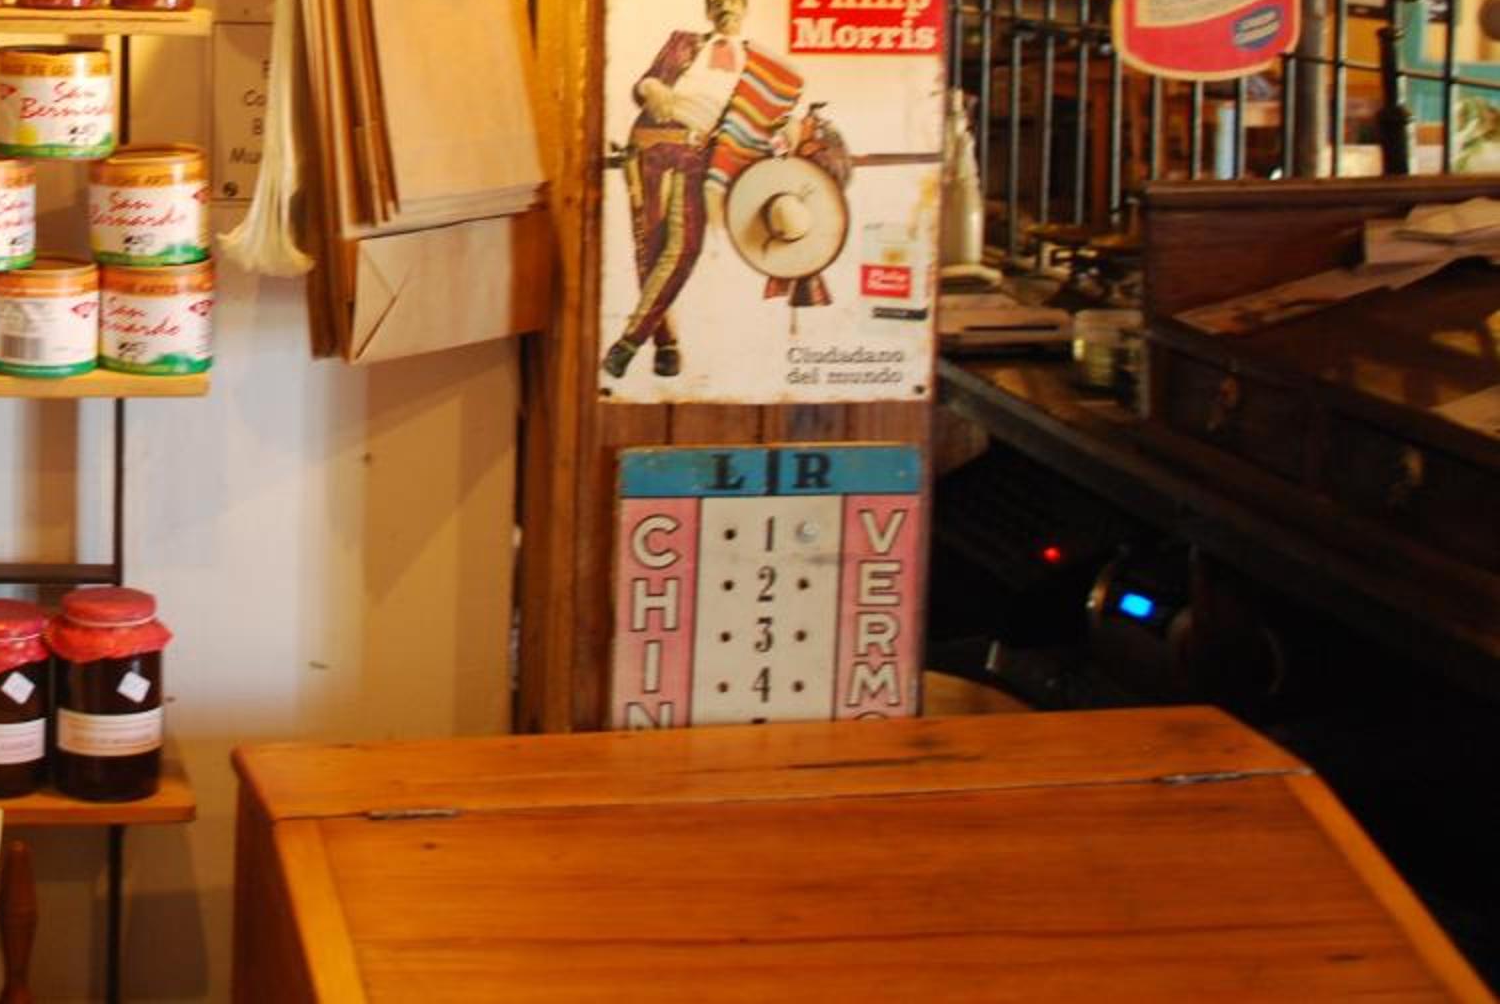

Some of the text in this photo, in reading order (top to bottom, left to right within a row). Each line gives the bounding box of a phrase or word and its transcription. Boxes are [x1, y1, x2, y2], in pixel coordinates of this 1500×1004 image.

[792, 17, 937, 49] Morris
[787, 345, 904, 364] Ciudadano
[787, 366, 903, 385] del mundo
[755, 566, 778, 602] 2
[846, 509, 908, 720] VERM
[753, 616, 775, 652] 3
[751, 666, 772, 703] 4
